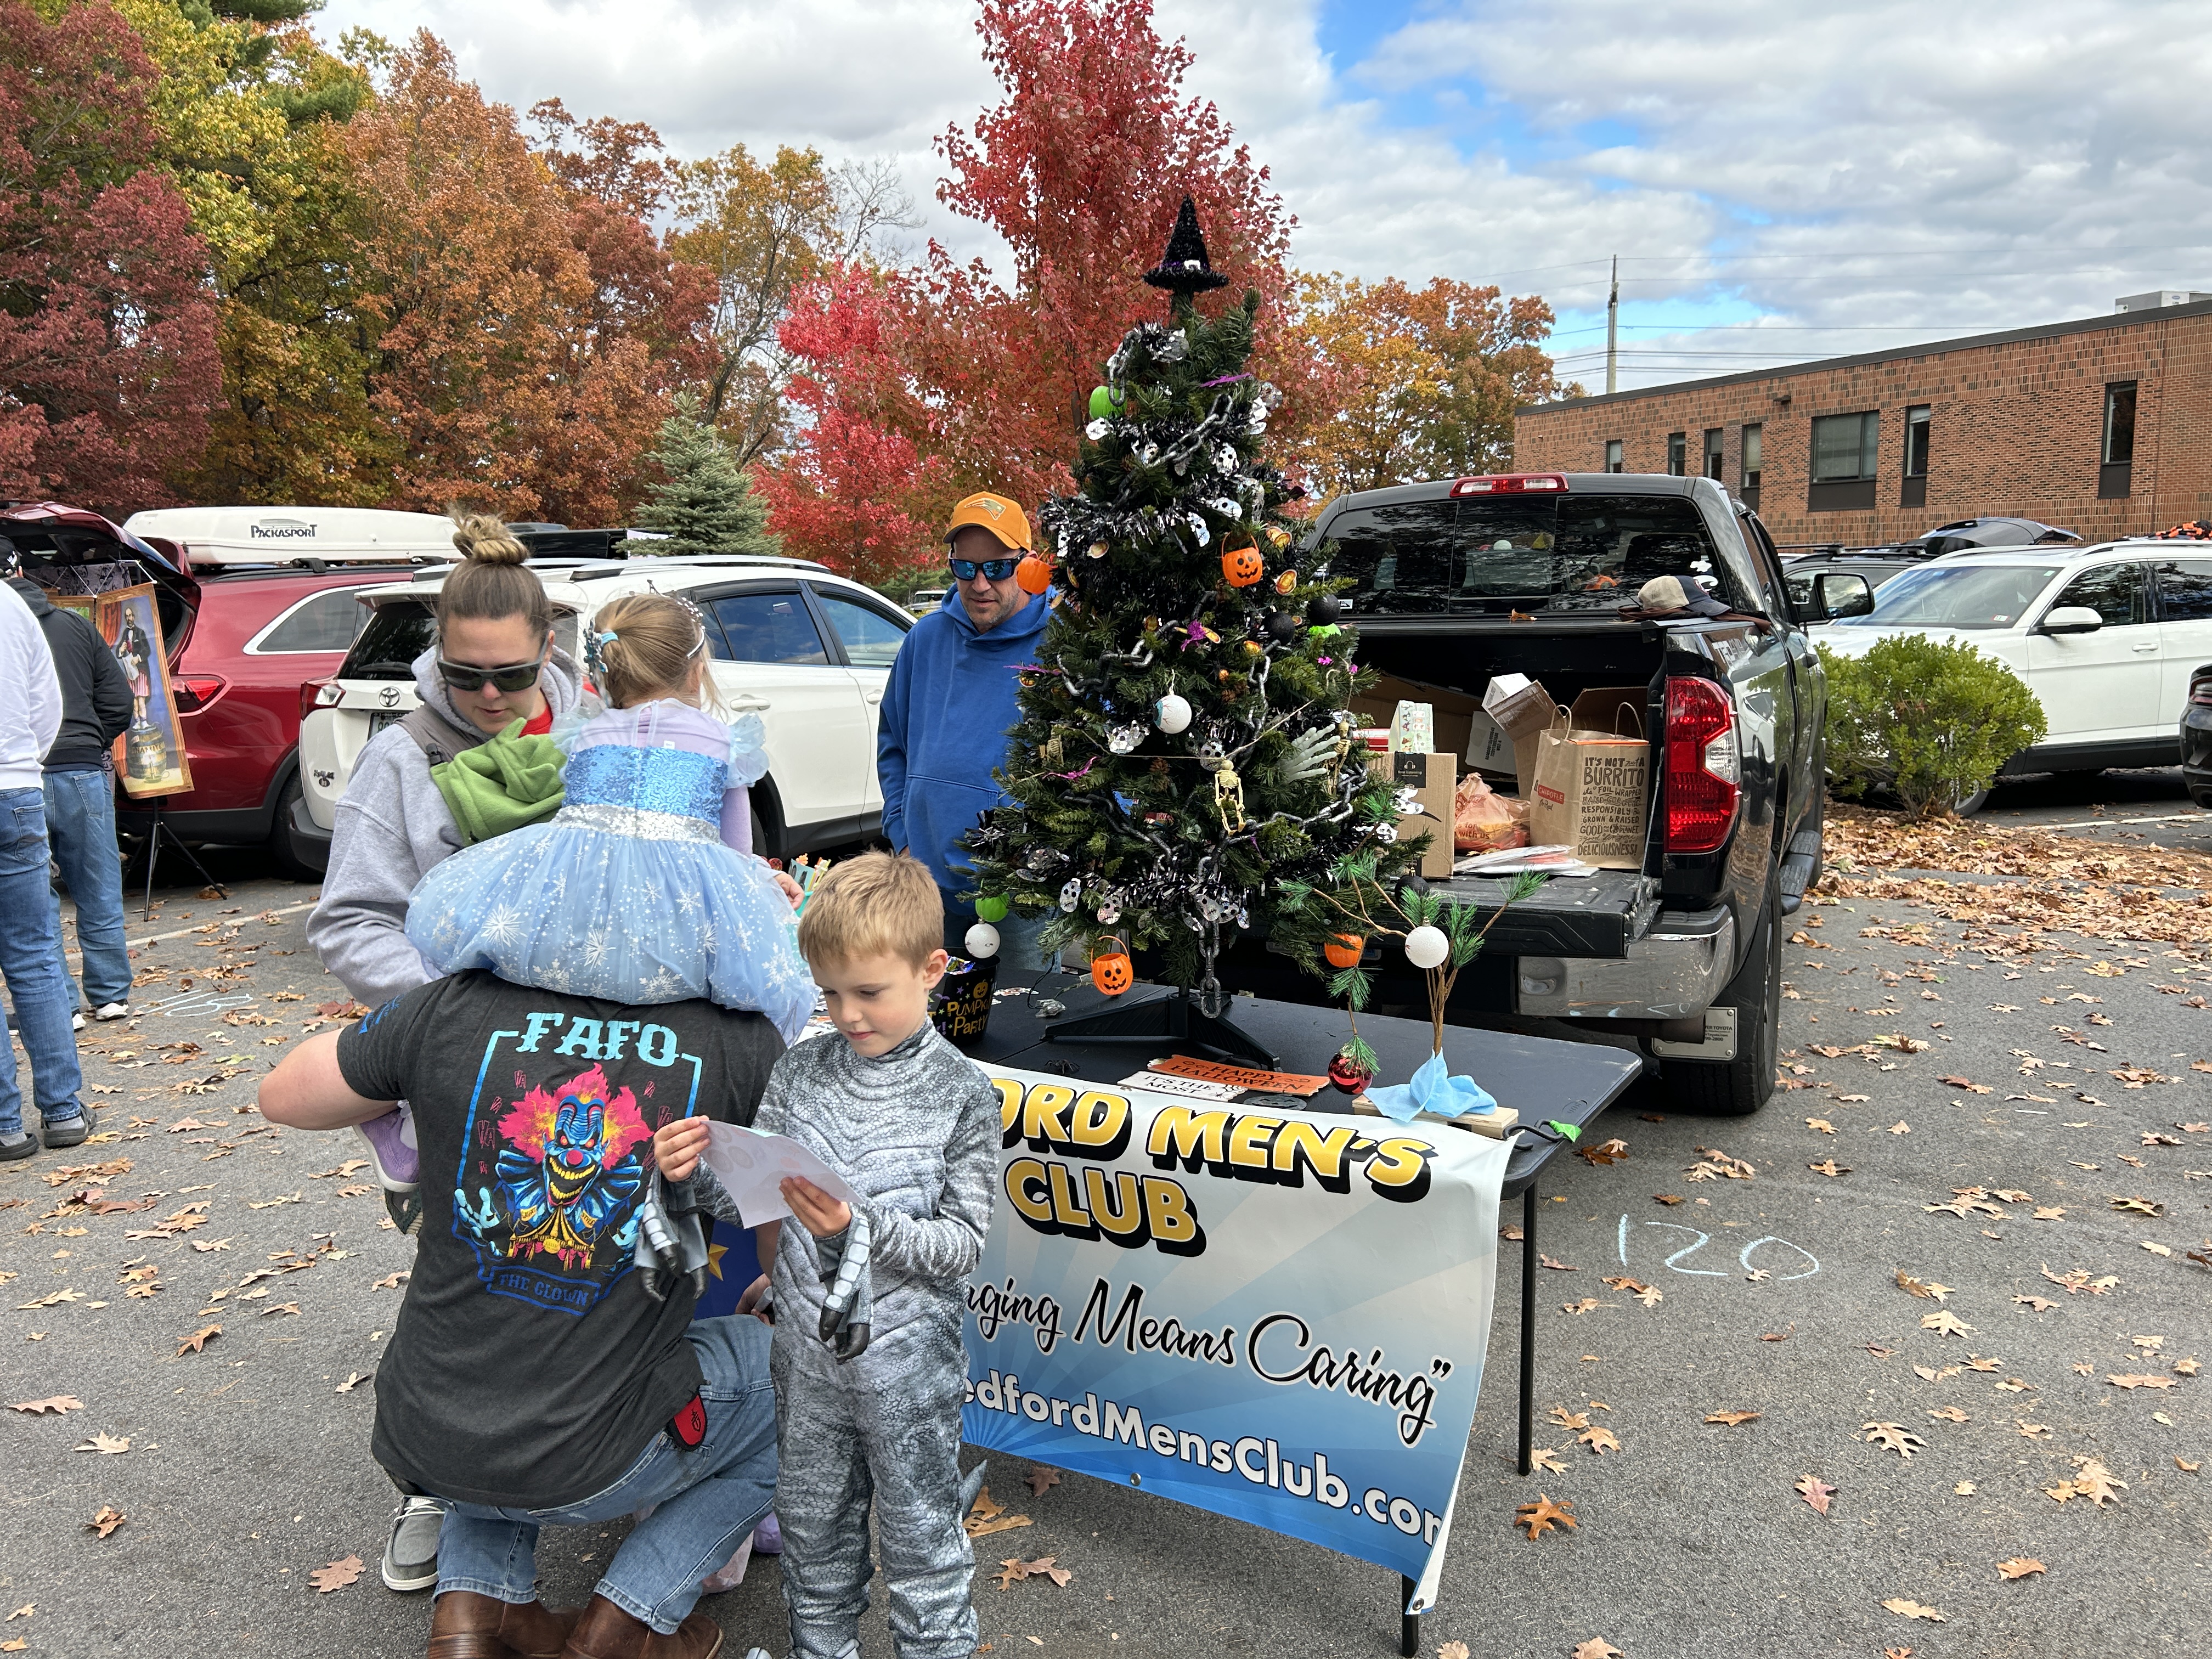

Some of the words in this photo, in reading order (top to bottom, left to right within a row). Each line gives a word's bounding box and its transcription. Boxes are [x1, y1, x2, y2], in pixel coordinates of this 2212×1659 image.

[251, 524, 318, 538] PACKASPORT
[1585, 757, 1602, 766] IT'S
[1605, 758, 1625, 767] NOT
[1639, 757, 1645, 766] A
[1584, 766, 1645, 787] BURRITO
[1538, 787, 1564, 802] CHIPOTLE
[1582, 806, 1630, 815] RESPONSIBLY
[1580, 825, 1602, 836] GOOD
[1582, 834, 1600, 845] good
[1577, 842, 1638, 856] DELICIOUSNESS!
[516, 1012, 680, 1067] FAFO
[1168, 1065, 1305, 1091] HALLOWEEN
[1209, 1066, 1281, 1081] HAPPY
[1144, 1075, 1177, 1085] IT'S
[1180, 1079, 1215, 1091] THE
[1146, 1082, 1203, 1094] MOST
[477, 1120, 495, 1150] HA
[991, 1078, 1132, 1161] ORD
[1146, 1105, 1438, 1203] MEN'S
[1003, 1157, 1207, 1257] CLUB
[1618, 1214, 1820, 1280] 120
[499, 1274, 531, 1291] THE
[534, 1281, 589, 1307] CLOWN
[1073, 1276, 1237, 1367] Means
